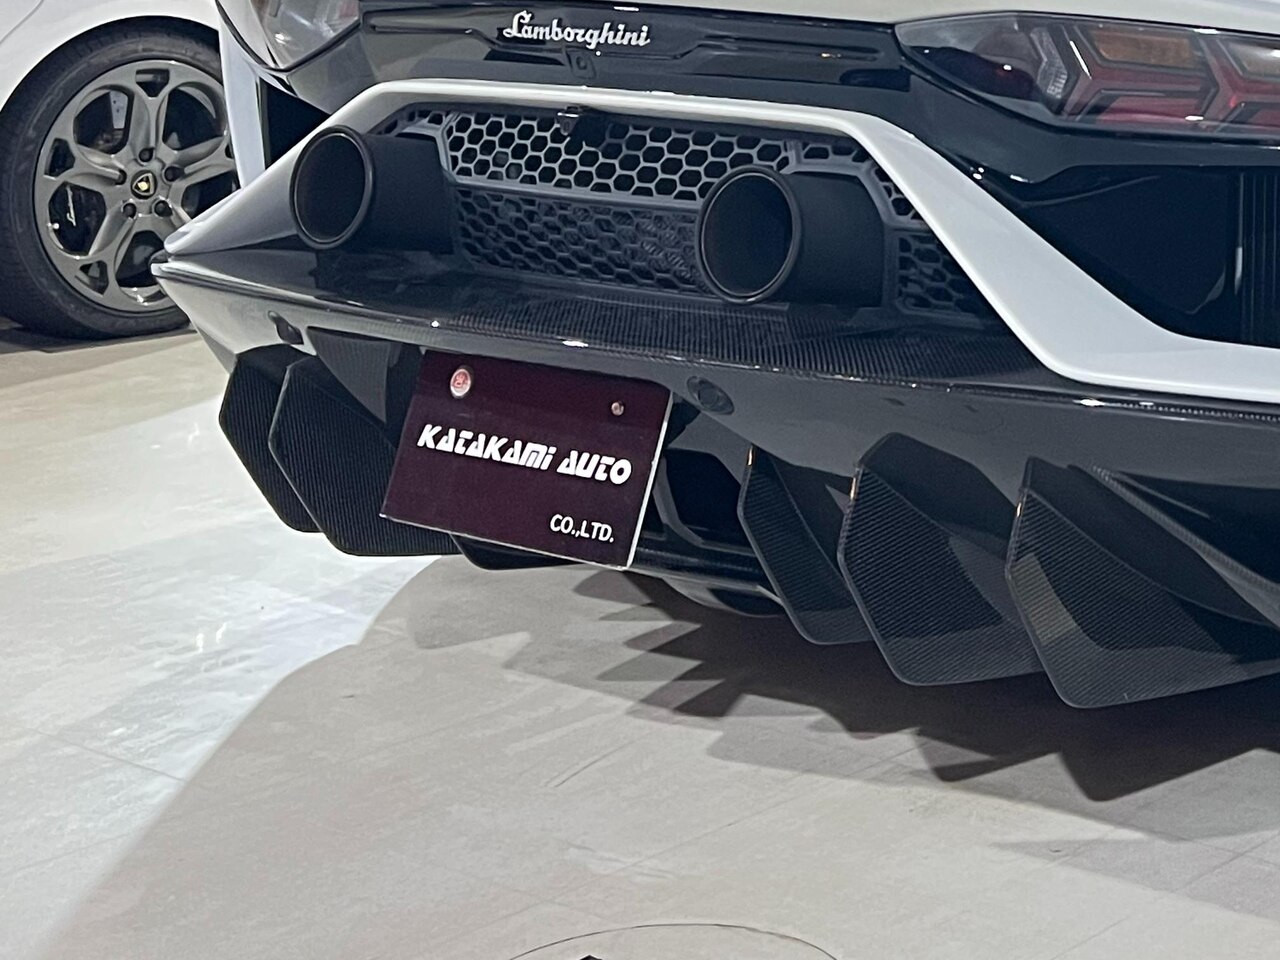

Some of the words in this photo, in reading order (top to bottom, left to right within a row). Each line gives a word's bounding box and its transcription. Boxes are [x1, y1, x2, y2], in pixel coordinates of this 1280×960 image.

[503, 10, 650, 49] Lamborghini
[556, 449, 632, 485] AUTO
[550, 513, 615, 543] CO.,LTD.
